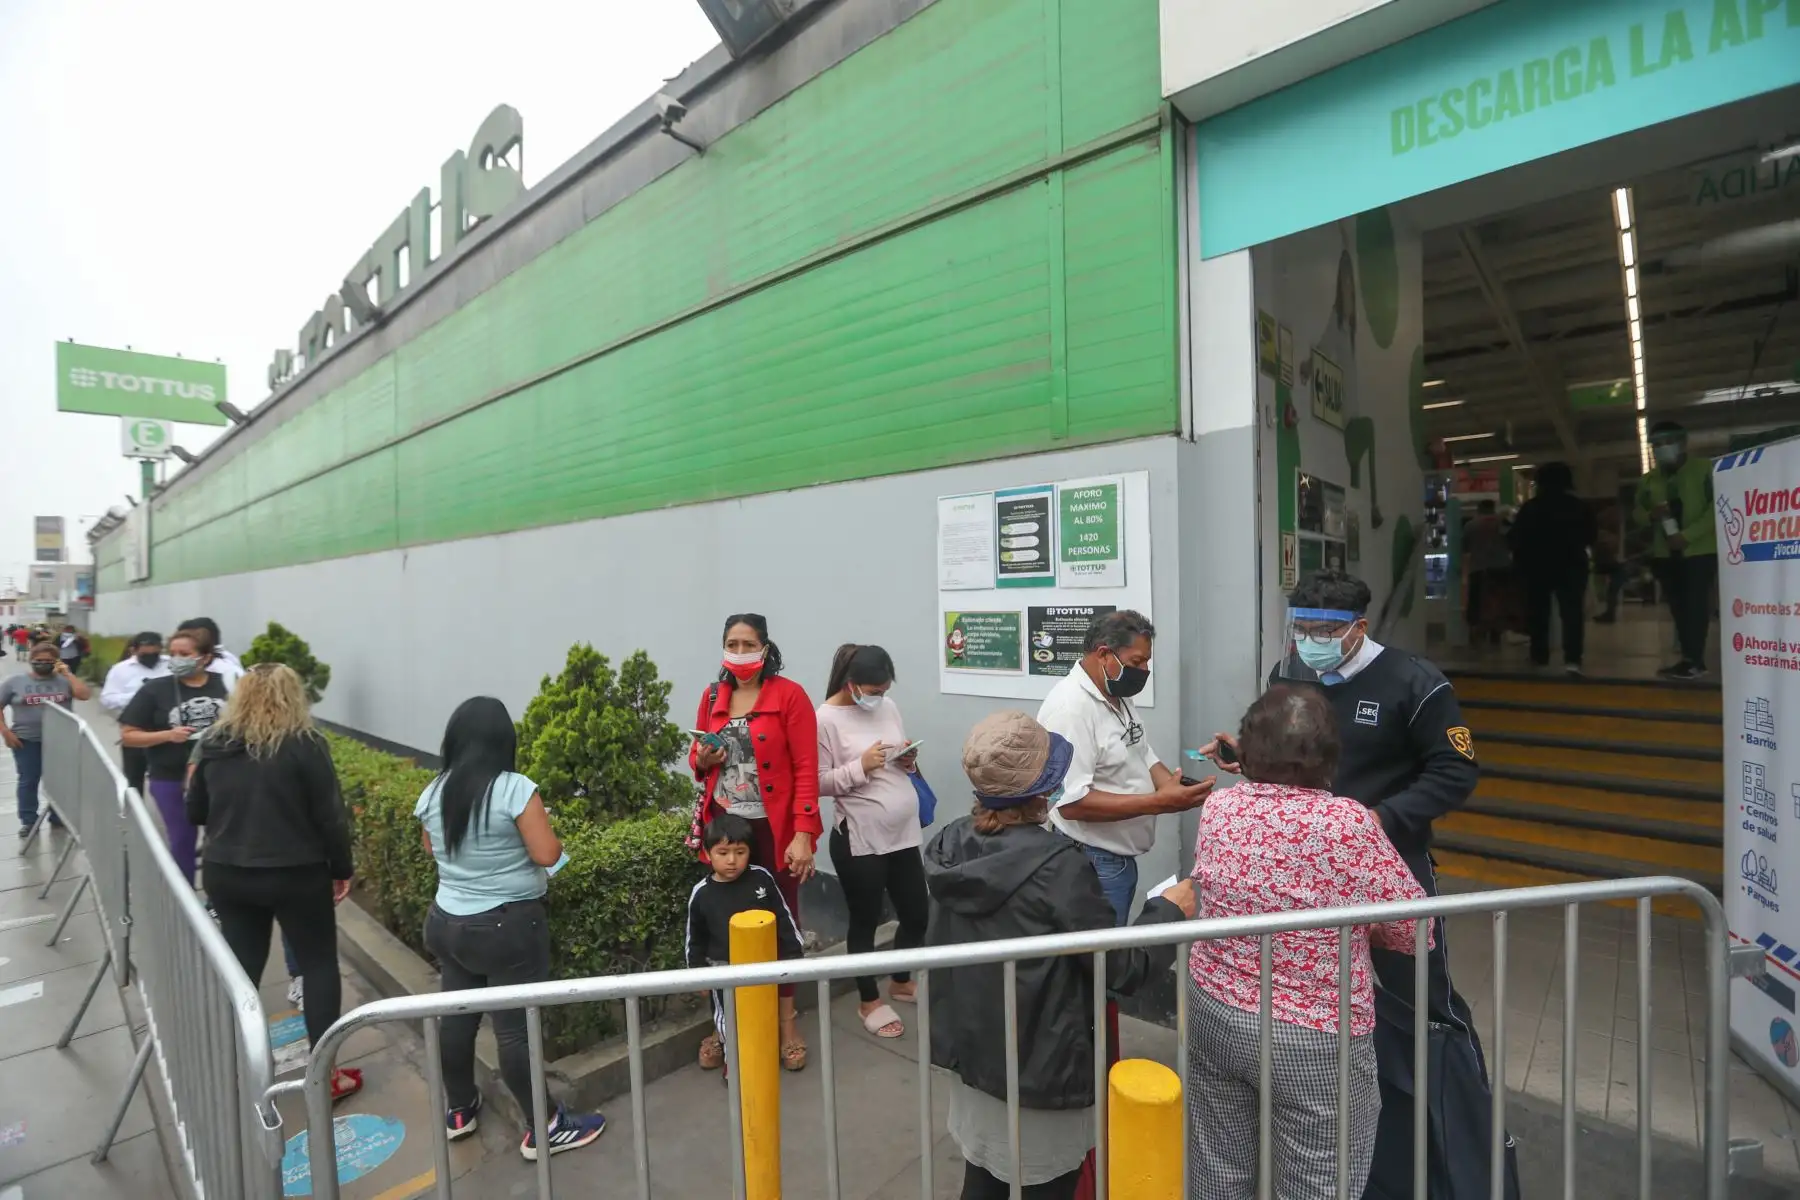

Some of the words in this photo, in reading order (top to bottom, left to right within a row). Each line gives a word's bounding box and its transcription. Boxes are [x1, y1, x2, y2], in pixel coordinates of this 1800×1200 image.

[1391, 36, 1616, 156] DESCARGA
[1630, 9, 1694, 79] LA
[100, 371, 217, 401] TOTTUS
[138, 423, 157, 446] E
[1073, 489, 1103, 499] AFORO
[1069, 501, 1107, 513] MAXIMO
[1073, 517, 1084, 525] AL
[1085, 515, 1103, 523] 80%
[1079, 533, 1099, 542] 1420
[1068, 545, 1111, 556] PERSONAS
[1744, 602, 1777, 615] Ponte
[1778, 601, 1791, 616] las
[1745, 636, 1777, 651] Ahora
[1778, 637, 1787, 653] la
[1744, 654, 1779, 668] estará
[1745, 734, 1777, 750] Barrios
[1746, 805, 1778, 827] Centros
[1742, 820, 1756, 834] de
[1757, 825, 1777, 843] salud
[1747, 886, 1780, 913] Parques
